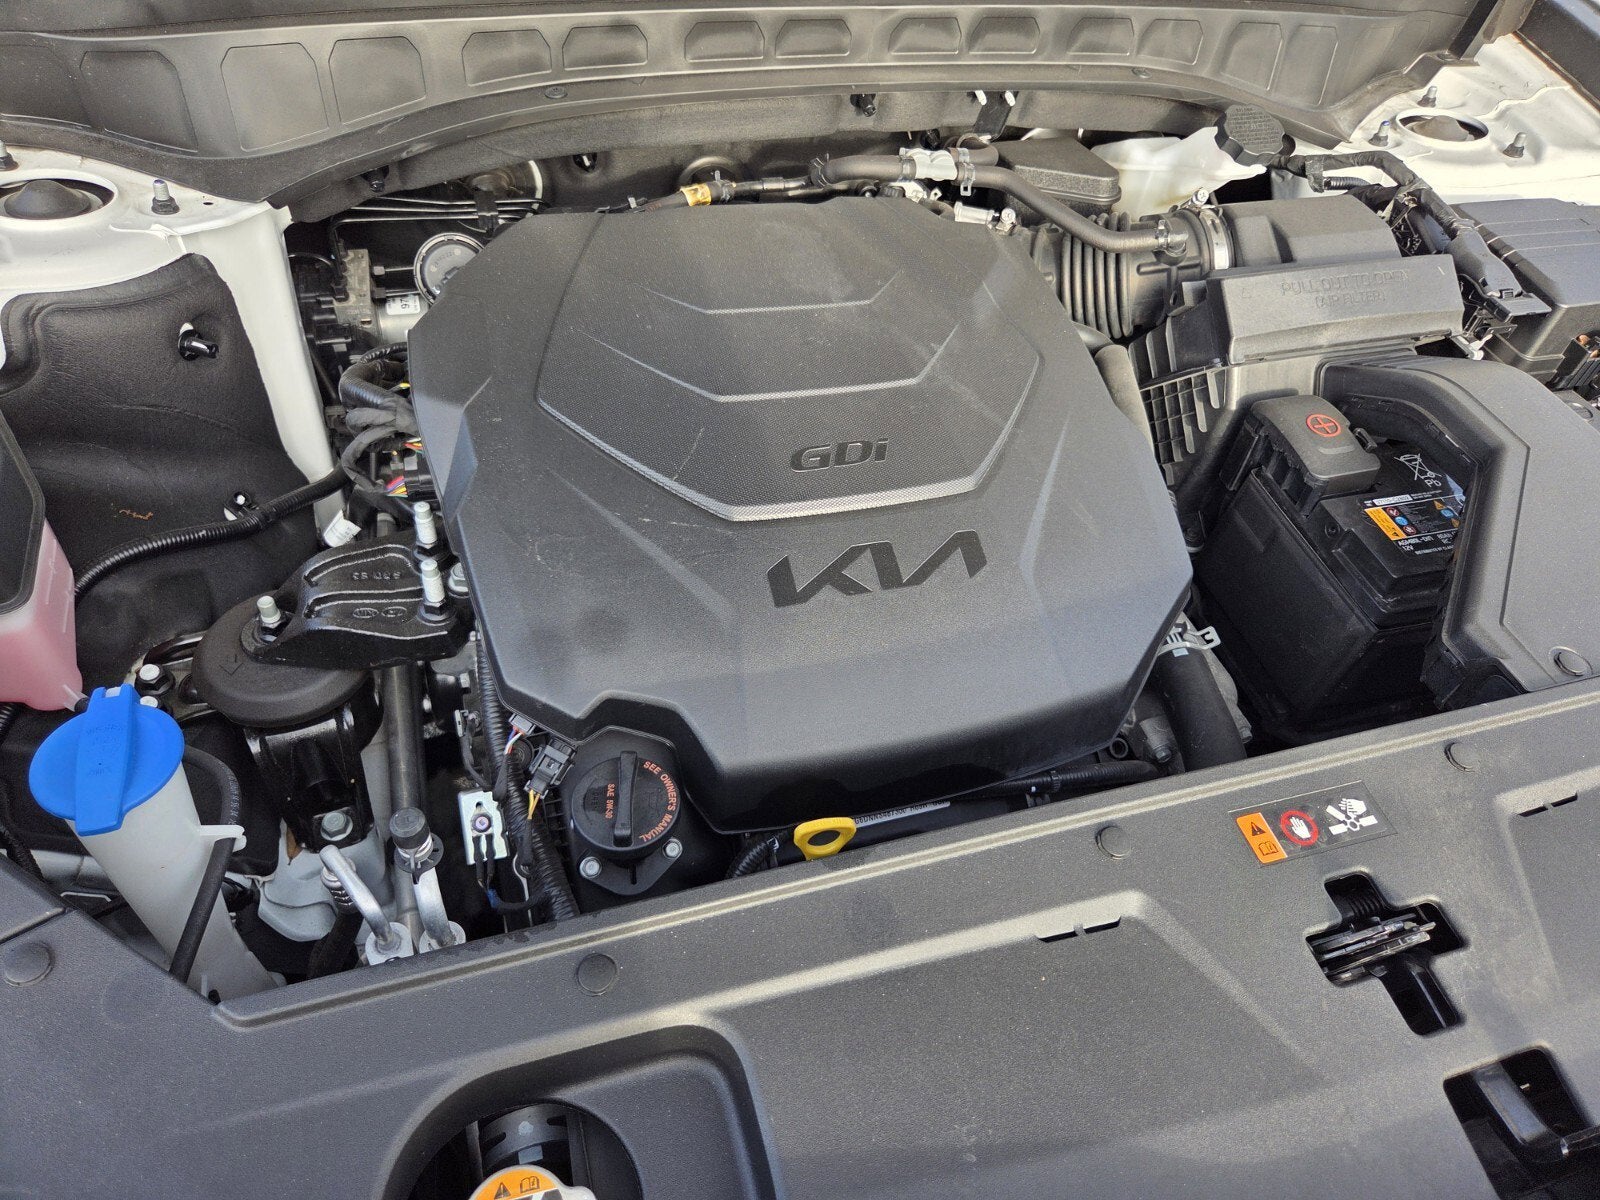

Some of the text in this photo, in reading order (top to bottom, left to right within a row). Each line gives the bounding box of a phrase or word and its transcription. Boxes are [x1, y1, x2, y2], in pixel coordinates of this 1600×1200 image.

[1281, 279, 1319, 296] PULL
[1321, 275, 1348, 291] OUT
[1351, 272, 1371, 287] TO
[790, 438, 889, 473] GDi
[1424, 478, 1442, 488] Pb
[607, 783, 616, 797] SAE
[639, 761, 677, 842] SEE OWNER'S MANUAL
